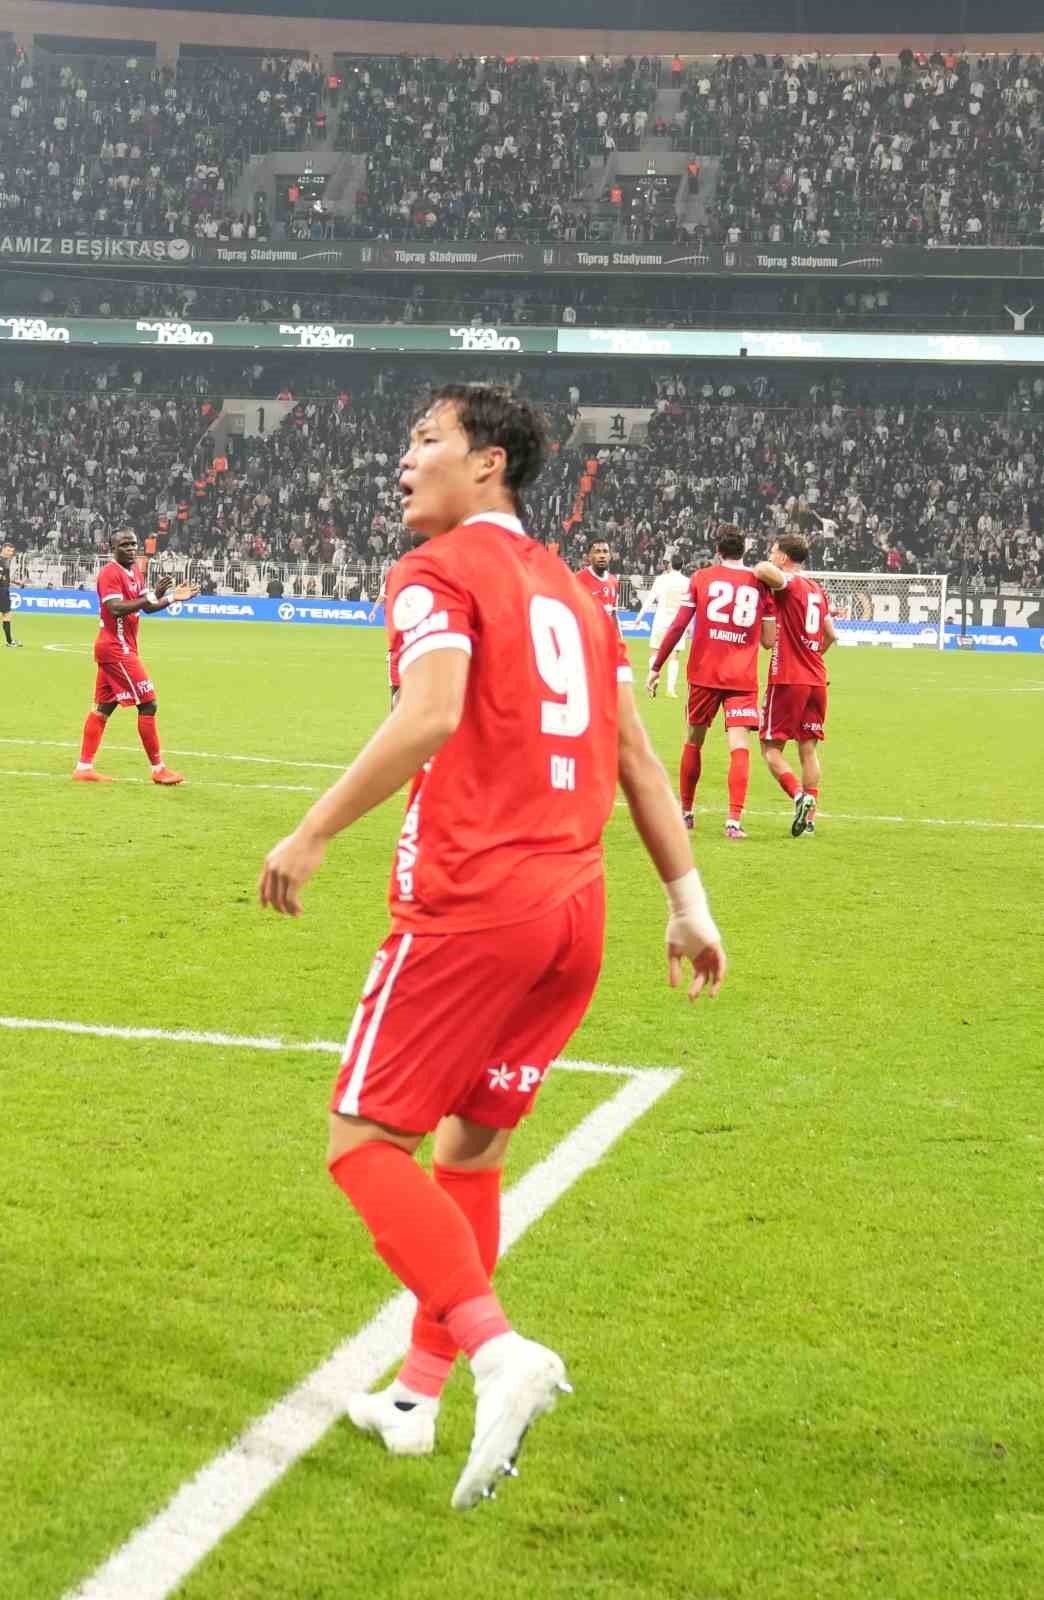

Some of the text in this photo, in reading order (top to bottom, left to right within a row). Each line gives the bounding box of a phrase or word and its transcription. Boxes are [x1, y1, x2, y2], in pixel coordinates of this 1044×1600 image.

[0, 236, 166, 261] AMIZ BEŞİKTAŞ
[217, 248, 297, 262] Tüpraş Stadyumu
[394, 250, 478, 264] Tüpraş Stadyumu
[577, 252, 662, 267] Tüpraş Stadyumu
[757, 255, 838, 269] Tüpraş Stadyumu
[22, 597, 92, 609] TEMSA
[178, 602, 255, 616] TEMSA
[707, 580, 760, 628] 28
[300, 607, 367, 621] TEMSA
[805, 593, 820, 634] 6
[944, 633, 1018, 647] TMSA
[529, 594, 591, 738] 9
[551, 755, 576, 791] OH
